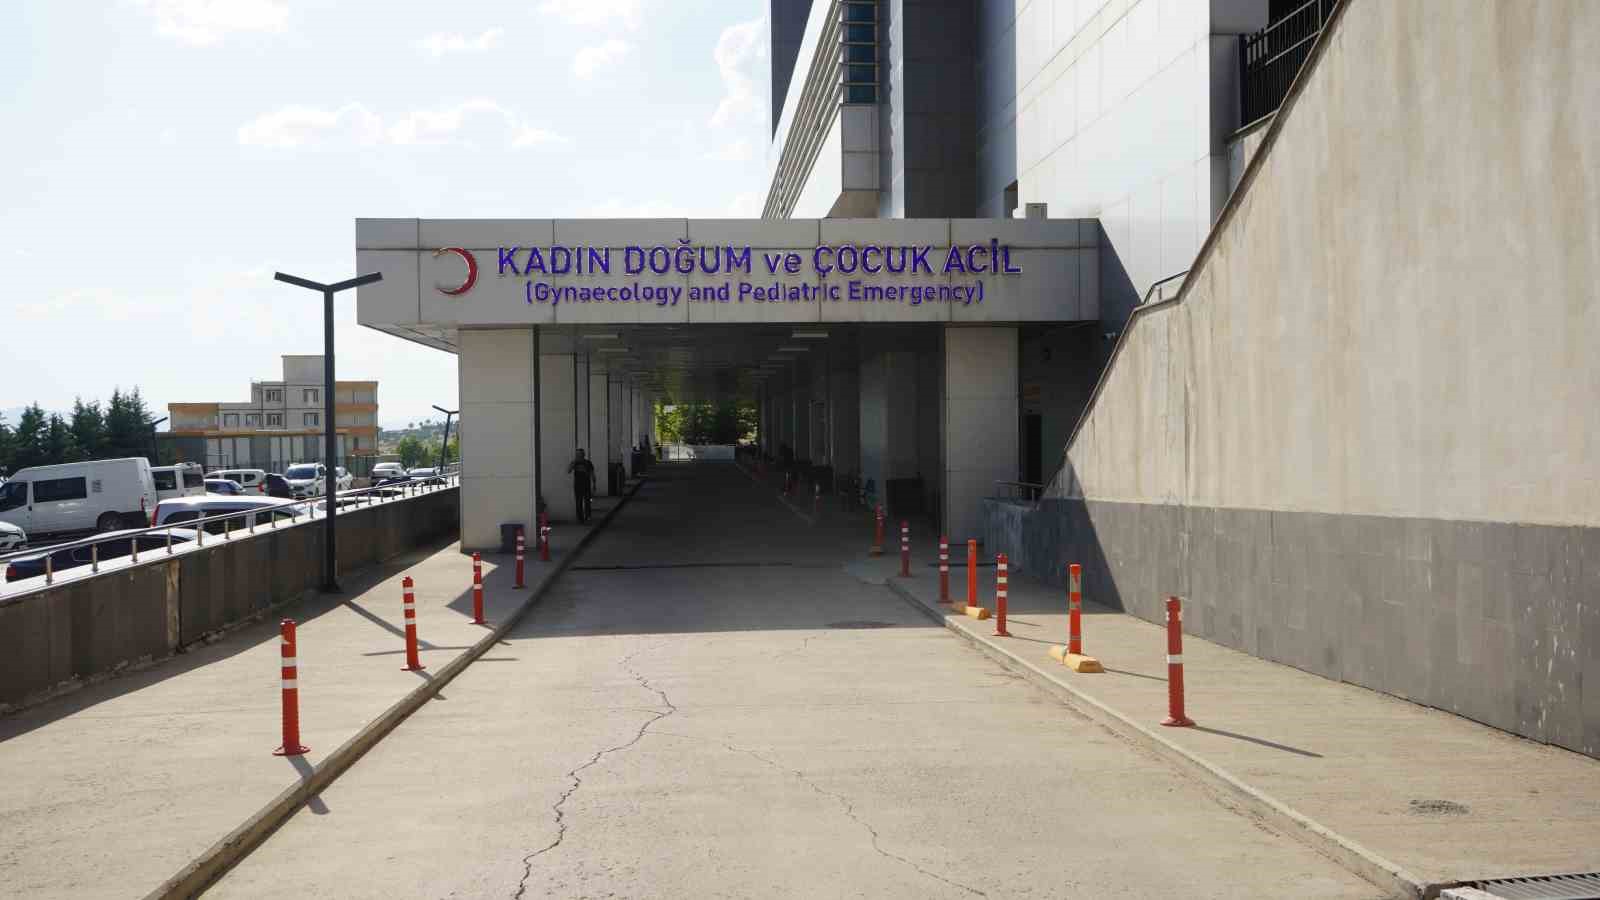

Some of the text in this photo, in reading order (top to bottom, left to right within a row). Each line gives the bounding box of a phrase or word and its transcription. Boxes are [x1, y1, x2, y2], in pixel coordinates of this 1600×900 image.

[498, 238, 1022, 278] KADIN DOĞUM ve ÇOCUK ACİL
[526, 280, 984, 305] (Gynaecology and Pediatric Emergency)
